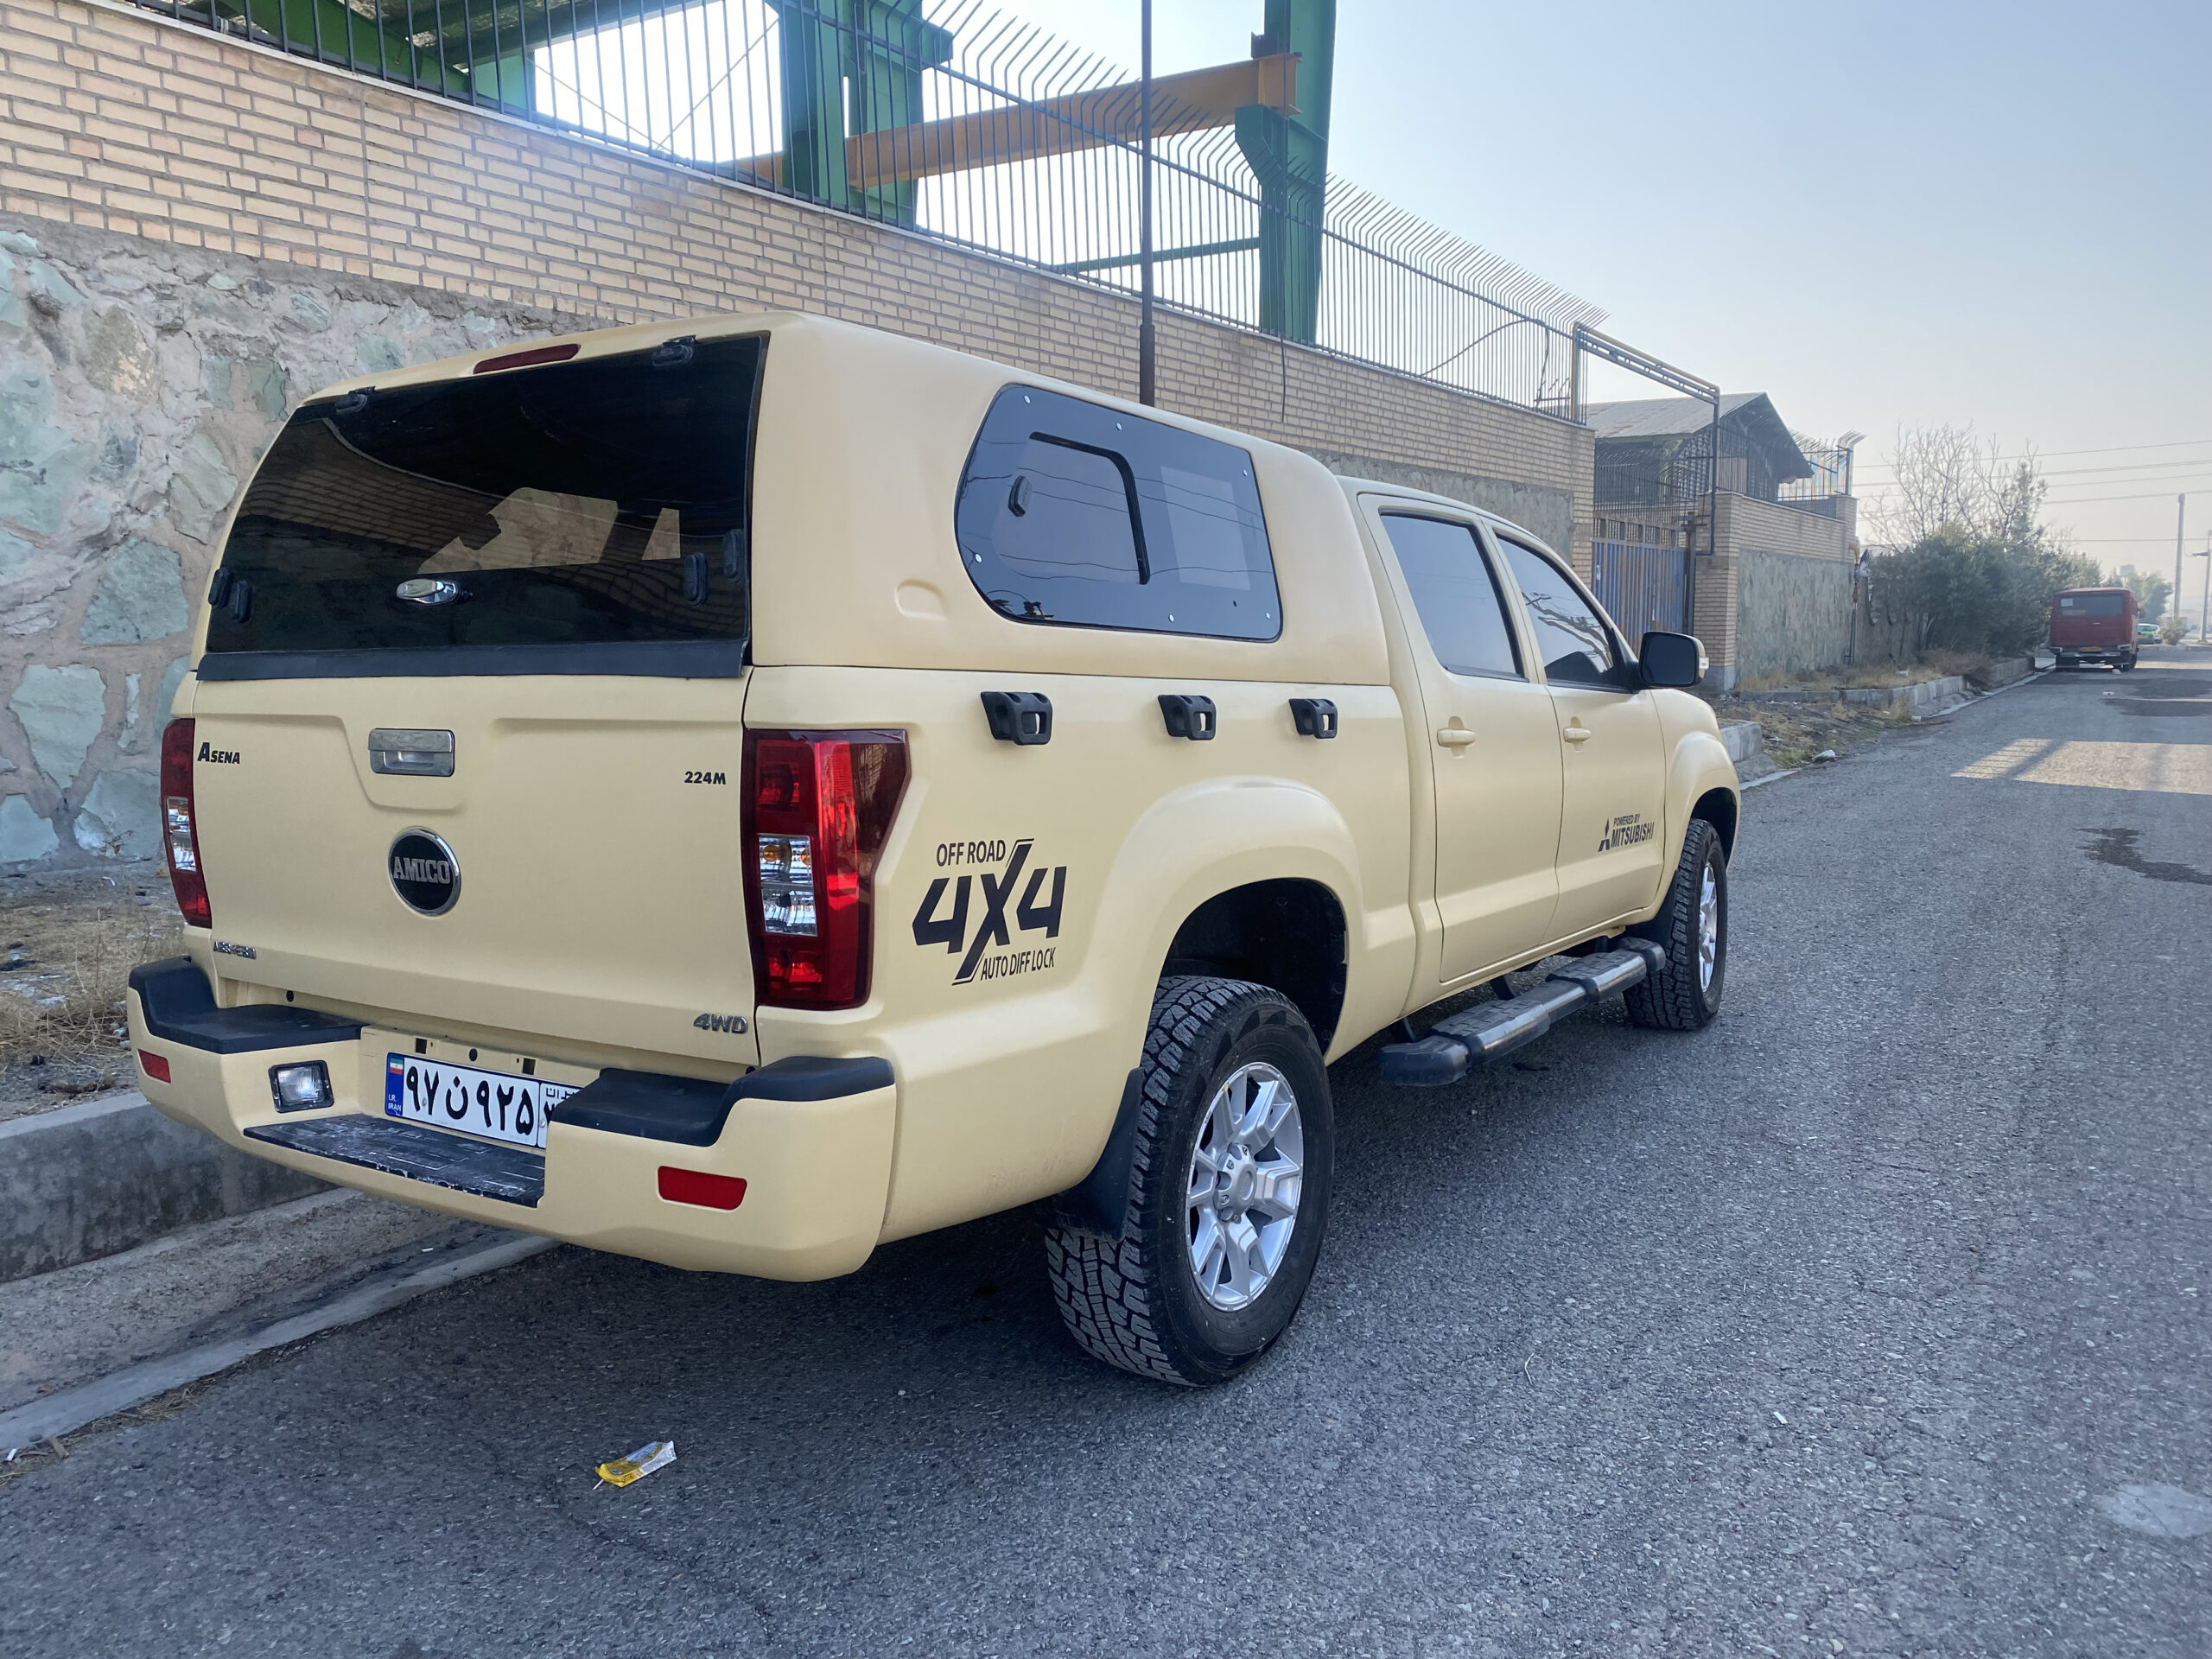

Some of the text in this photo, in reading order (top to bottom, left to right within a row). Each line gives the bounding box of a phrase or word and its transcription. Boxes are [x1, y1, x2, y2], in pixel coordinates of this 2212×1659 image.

[684, 771, 727, 785] 224M
[1613, 813, 1641, 827] POWERED BY
[1611, 822, 1655, 848] MITSUBISHI
[937, 839, 1006, 867] OFF ROAD
[393, 856, 451, 884] AMICO
[980, 947, 1056, 981] AUTO DIFF LOCK
[693, 1013, 749, 1034] 4WD
[388, 1102, 402, 1112] IRAN
